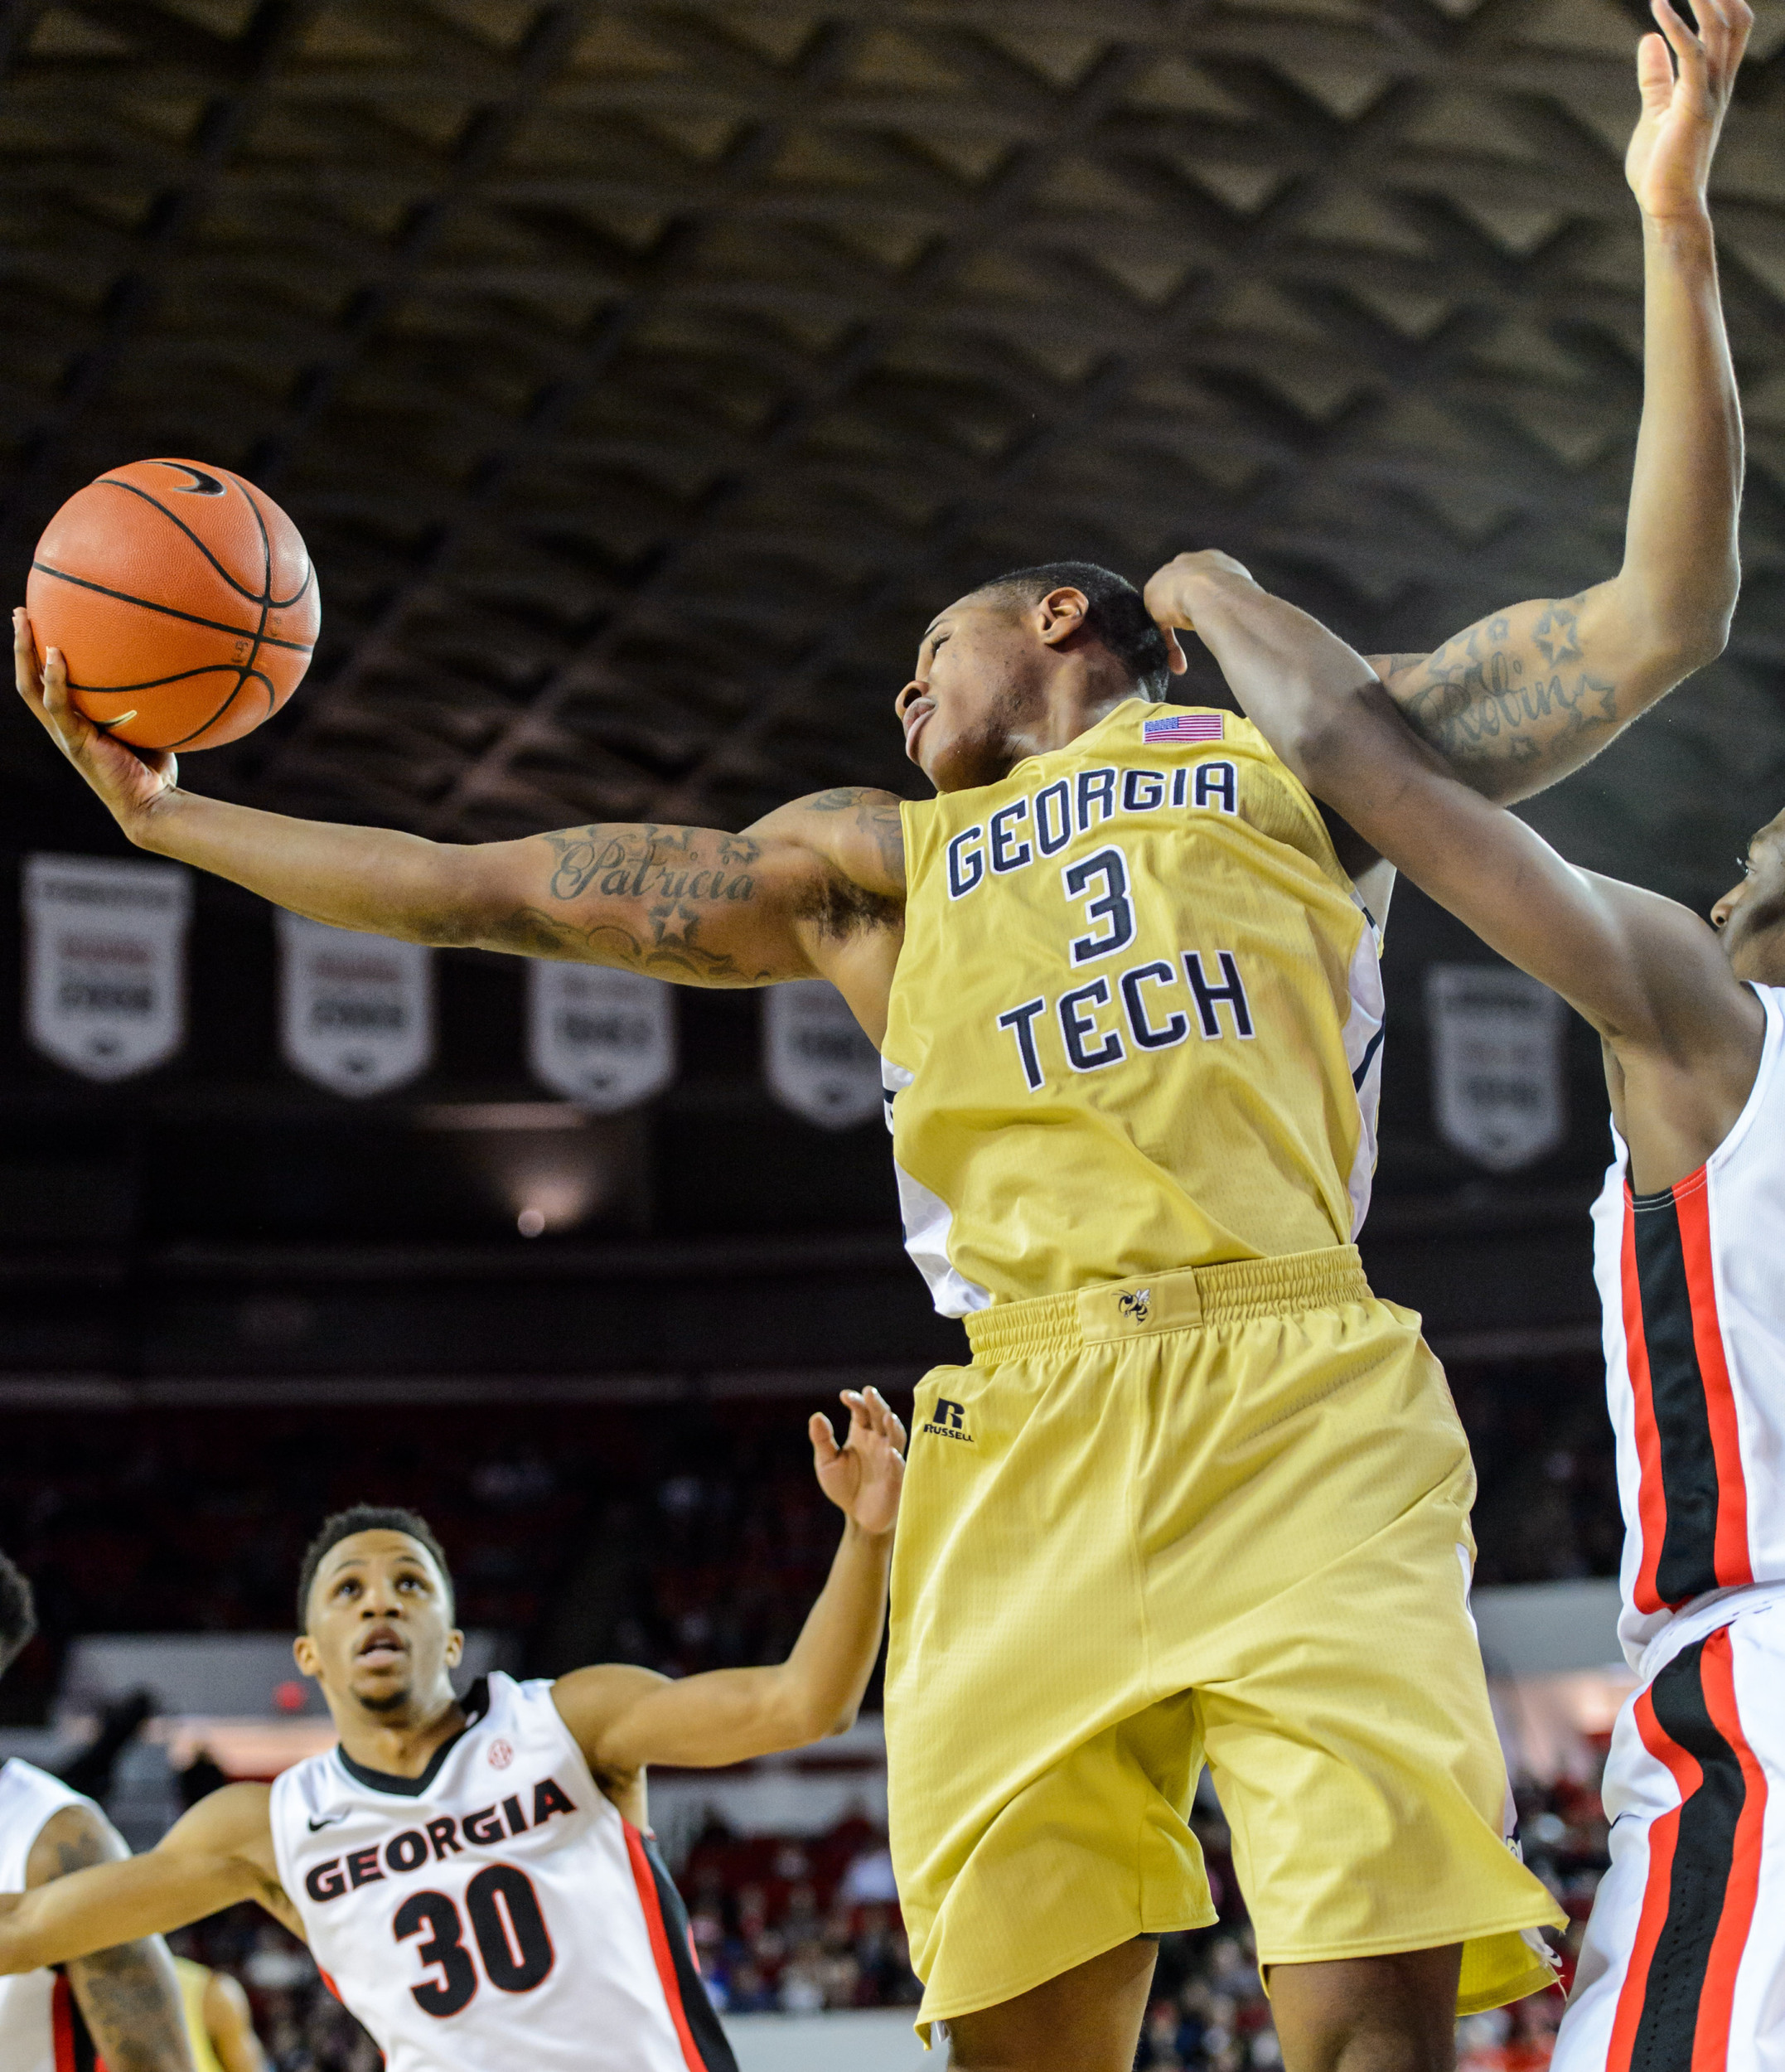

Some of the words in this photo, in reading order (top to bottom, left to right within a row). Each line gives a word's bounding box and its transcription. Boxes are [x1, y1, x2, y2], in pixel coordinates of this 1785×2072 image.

[551, 833, 758, 901] Patricia
[946, 760, 1239, 902] GEORGIA
[1061, 844, 1138, 968] 3
[997, 949, 1257, 1093] TECH
[923, 1423, 975, 1442] RUSSELL
[305, 1777, 578, 1903] GEORGIA
[392, 1861, 556, 2019] 30
